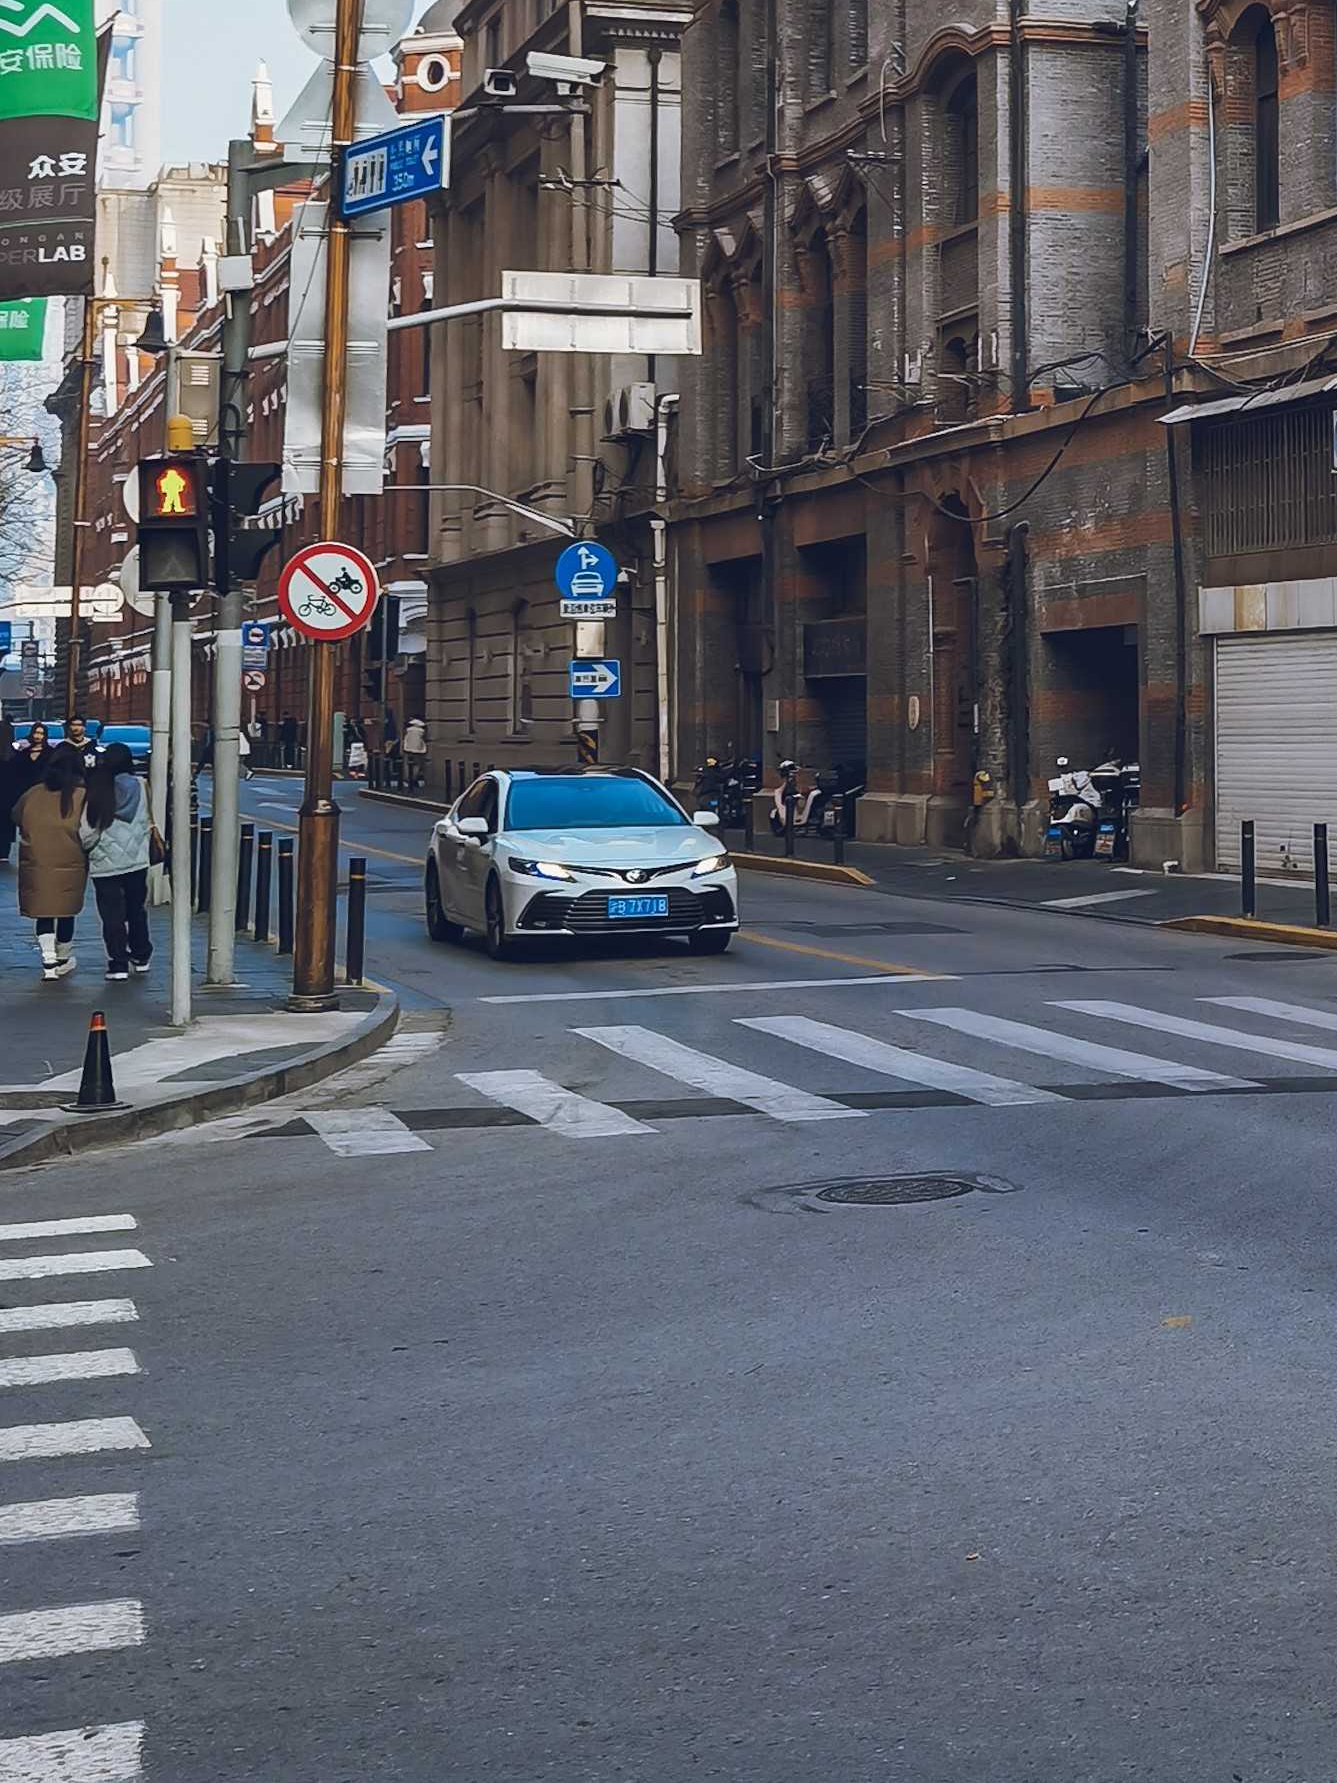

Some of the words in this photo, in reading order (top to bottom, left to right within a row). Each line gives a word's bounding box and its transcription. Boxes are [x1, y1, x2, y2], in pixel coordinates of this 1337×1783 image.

[0, 43, 83, 75] 安保险
[27, 152, 87, 179] 众安
[0, 183, 86, 211] 级展厅
